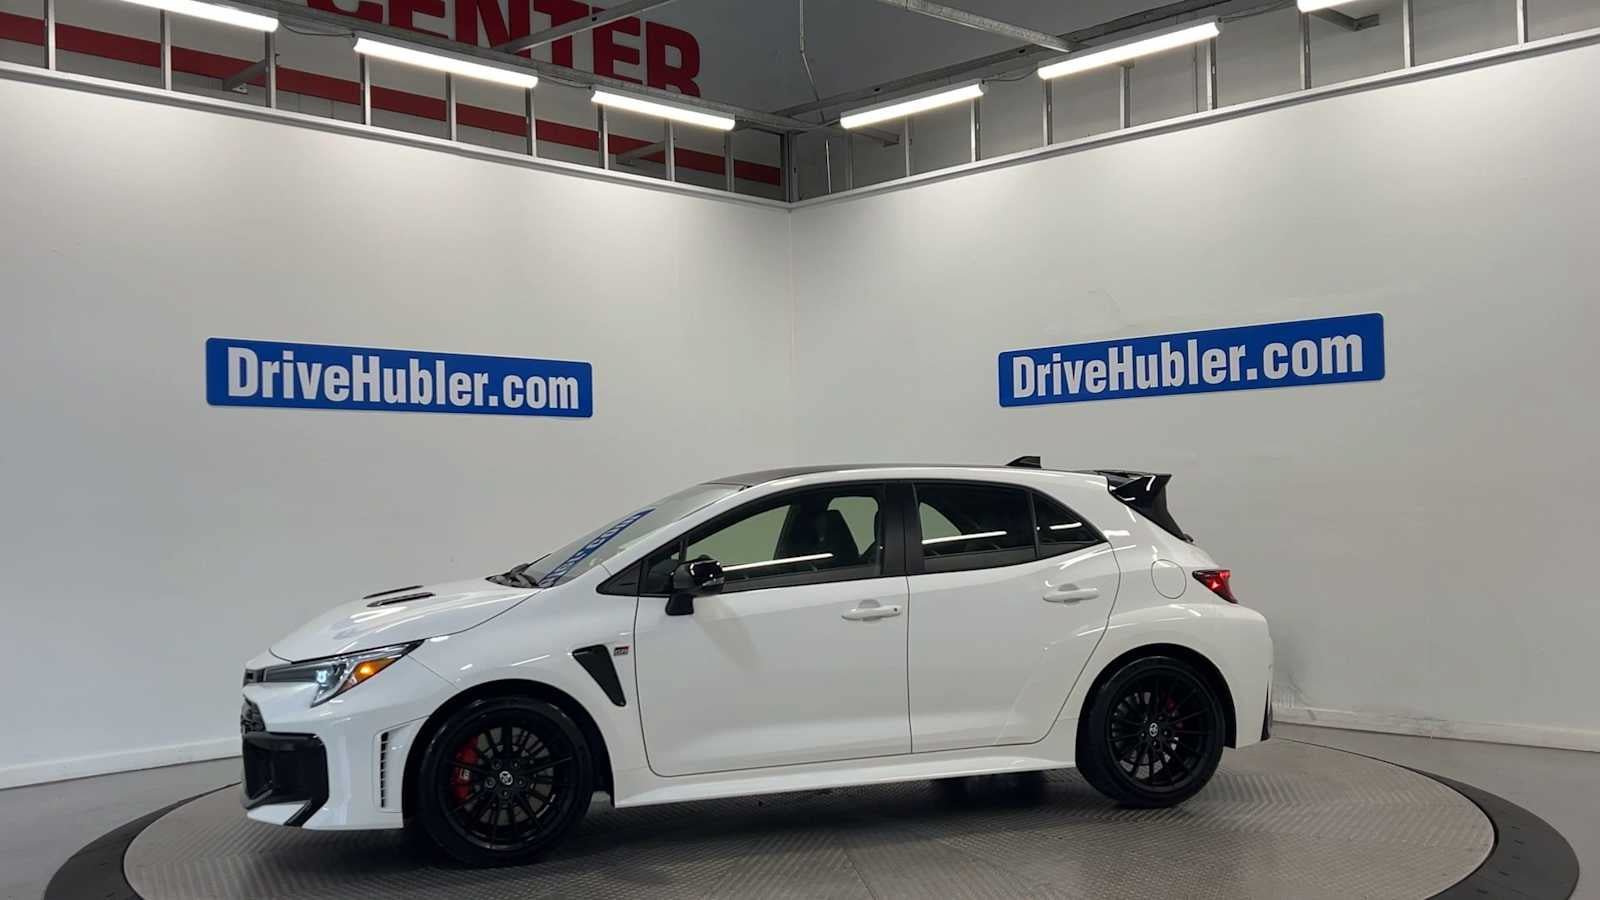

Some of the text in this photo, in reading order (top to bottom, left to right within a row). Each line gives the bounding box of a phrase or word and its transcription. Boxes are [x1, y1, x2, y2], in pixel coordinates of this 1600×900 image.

[307, 0, 701, 98] NTER
[227, 346, 579, 410] DriveHubler.com
[1012, 333, 1363, 399] DriveHubler.com
